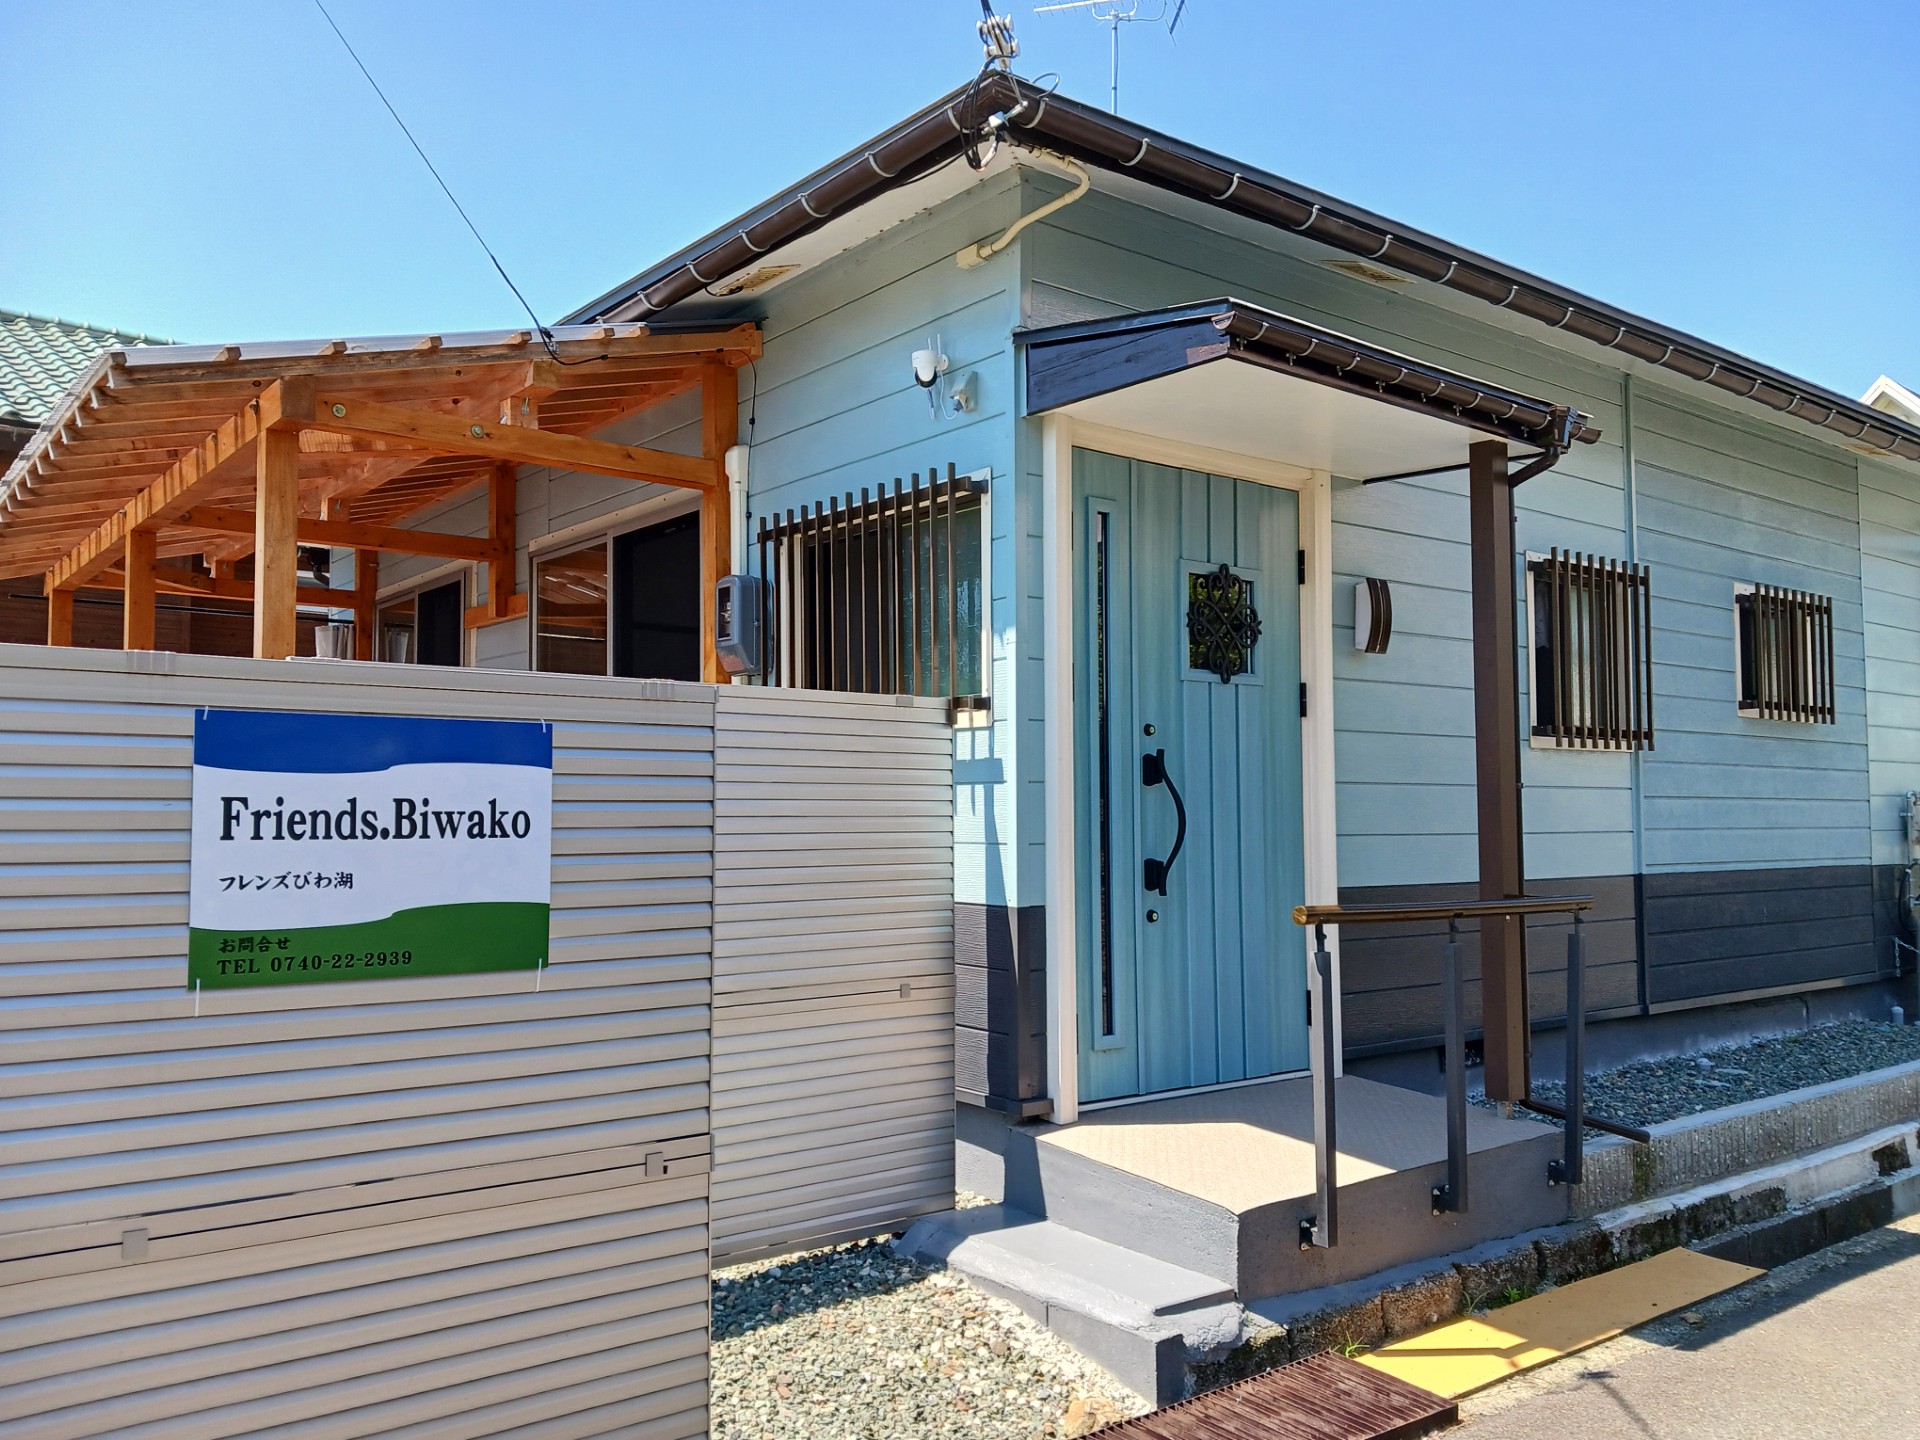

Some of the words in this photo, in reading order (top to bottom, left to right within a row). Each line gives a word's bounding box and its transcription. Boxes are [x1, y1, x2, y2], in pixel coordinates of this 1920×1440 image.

[218, 871, 354, 891] フレンズびわ湖
[218, 936, 290, 953] お問合せ
[216, 959, 260, 975] TEL
[270, 950, 412, 973] 0740-22-2939
